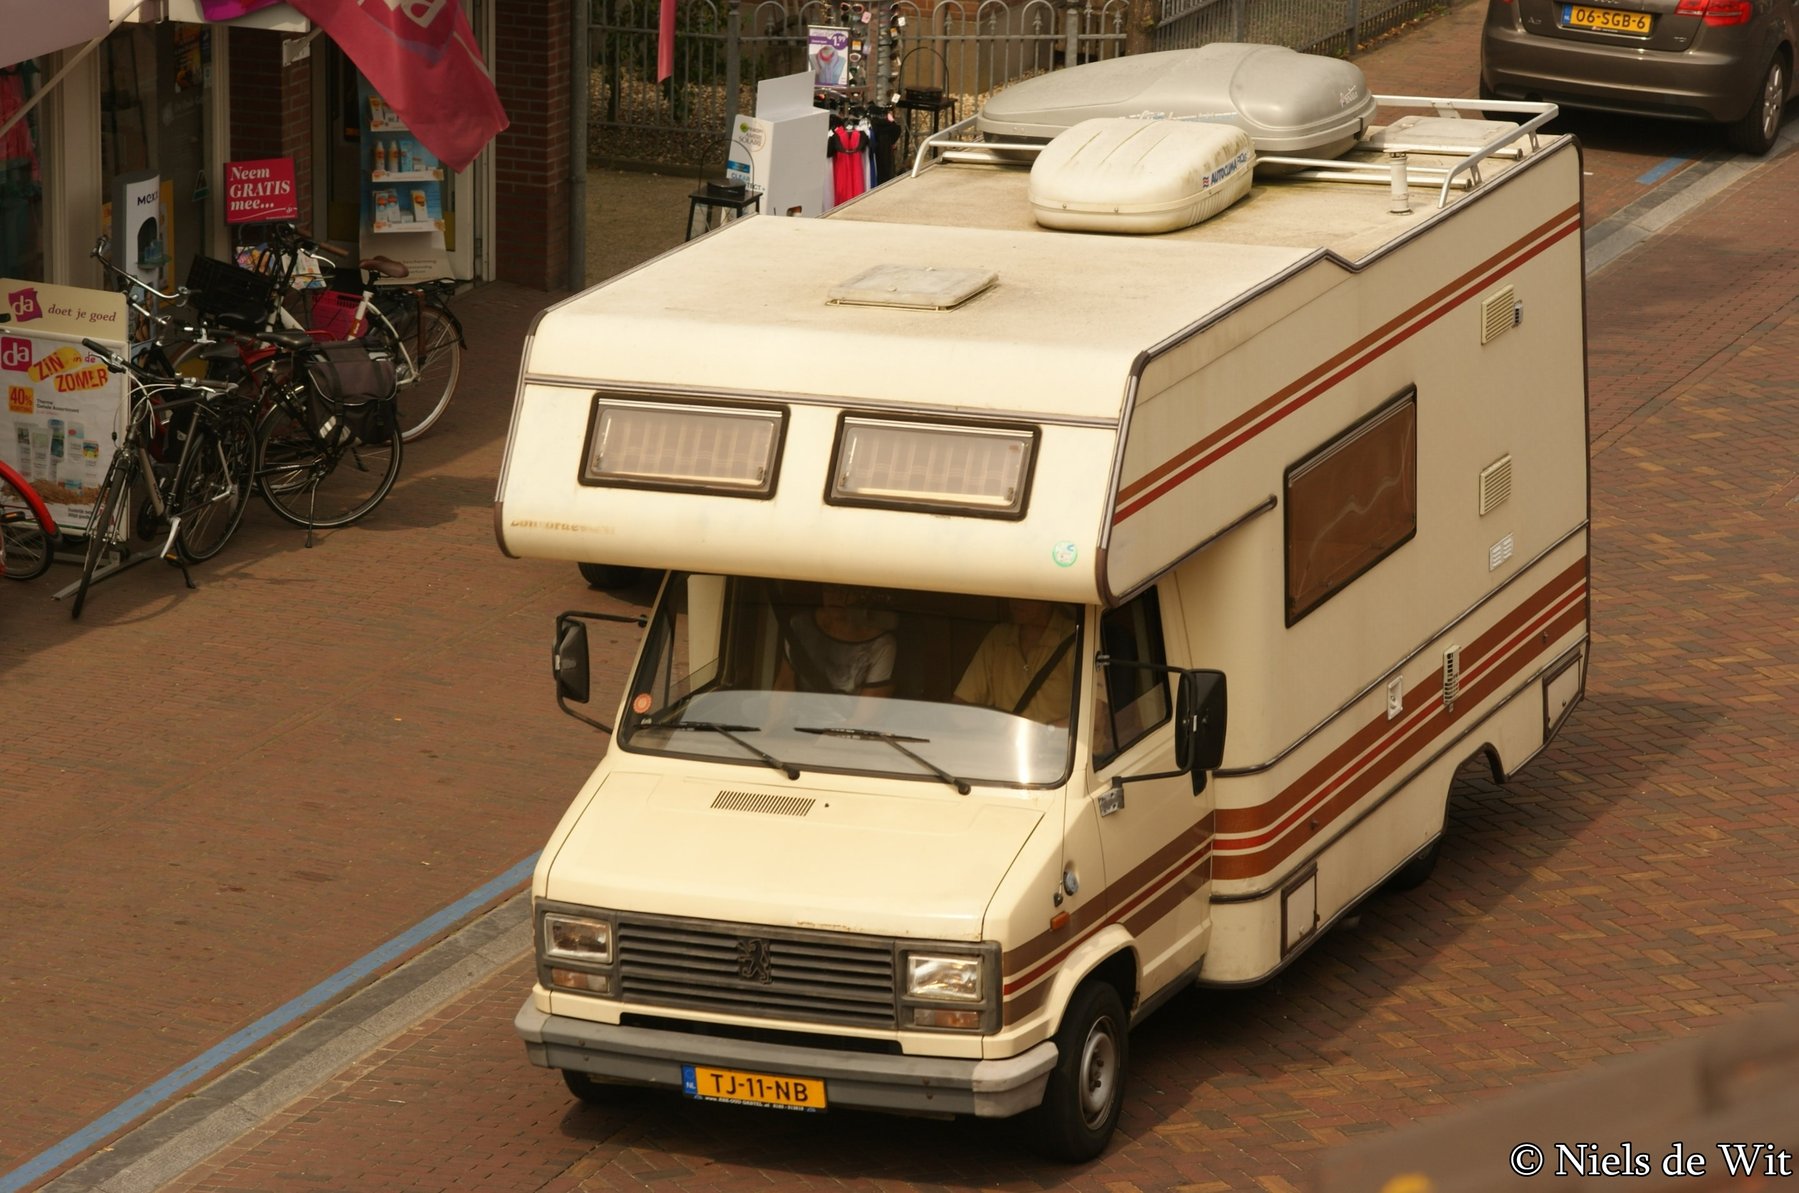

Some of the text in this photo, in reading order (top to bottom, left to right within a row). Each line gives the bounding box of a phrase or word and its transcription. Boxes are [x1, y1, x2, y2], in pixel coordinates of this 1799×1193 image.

[1576, 8, 1646, 29] 06-SGB-6
[230, 166, 270, 181] Neem
[229, 180, 291, 198] GRATIS
[230, 199, 274, 211] mee...
[13, 295, 117, 322] da doet je goed
[3, 342, 30, 366] da
[34, 352, 65, 381] ZIN
[55, 368, 108, 392] ZOMER
[710, 1073, 808, 1102] TJ-11-NB
